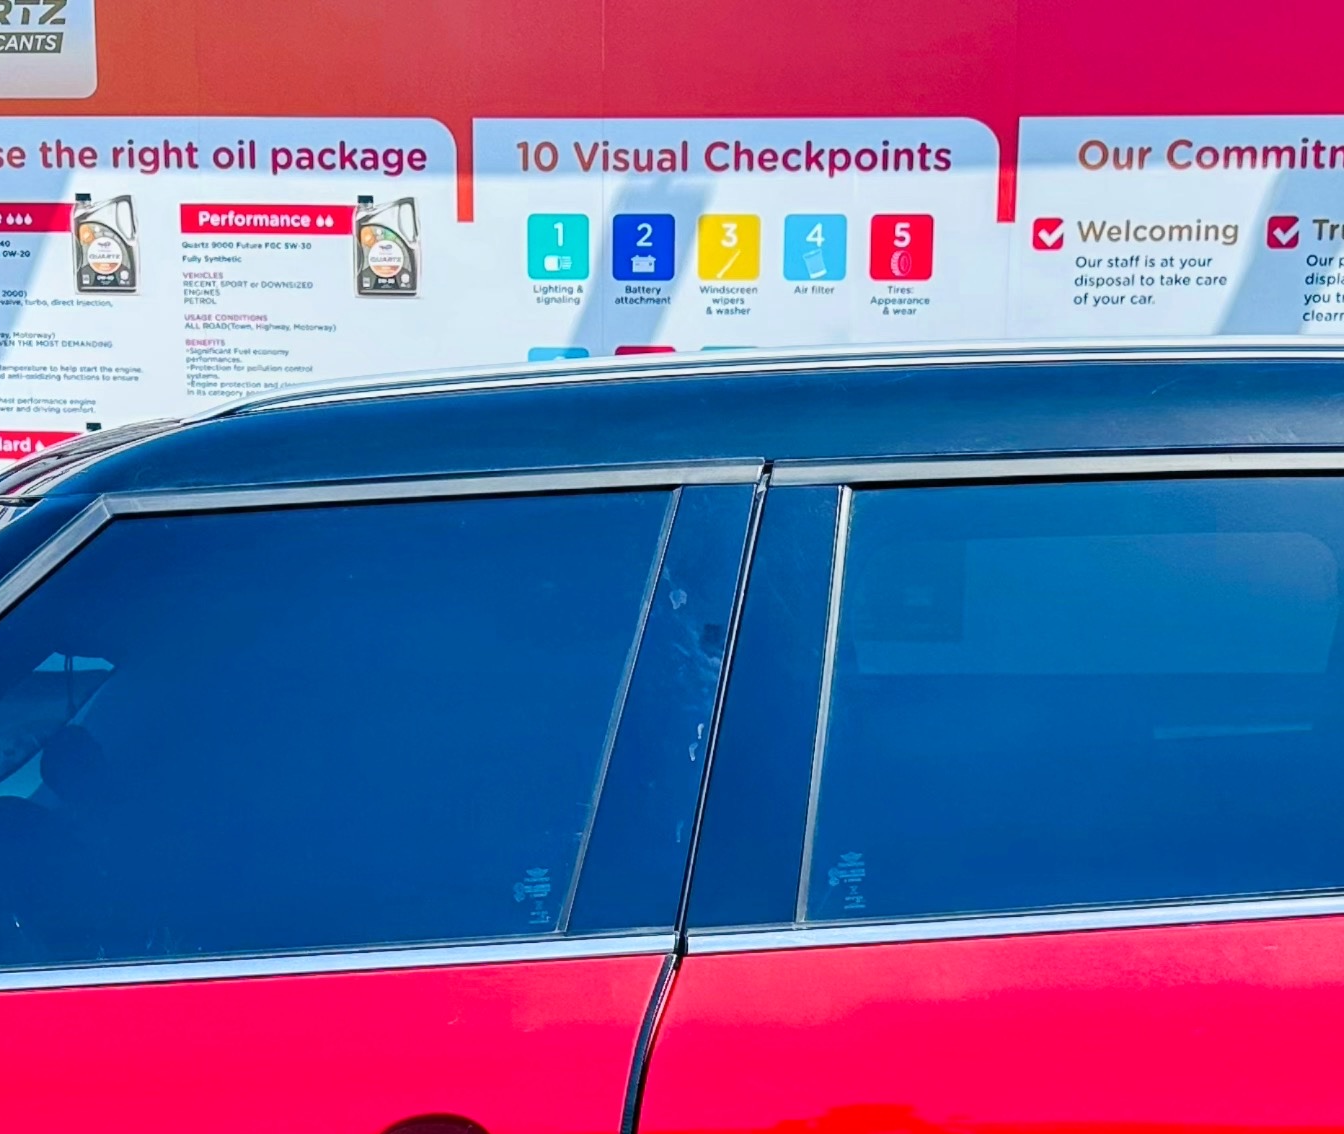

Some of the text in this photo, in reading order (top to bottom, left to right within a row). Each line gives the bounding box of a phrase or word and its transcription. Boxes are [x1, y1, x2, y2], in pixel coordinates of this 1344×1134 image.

[39, 139, 99, 171] the
[111, 139, 201, 176] right
[209, 139, 258, 171] oil
[270, 141, 429, 177] package
[516, 140, 953, 178] 10 Visual Checkpoints
[1077, 140, 1154, 171] Our
[198, 210, 312, 228] Performance
[553, 223, 564, 247] 1
[636, 223, 653, 247] 2
[721, 223, 739, 247] 3
[806, 222, 826, 248] 4
[893, 222, 912, 248] 5
[1076, 218, 1240, 247] Welcoming
[1074, 254, 1214, 271] Our staff is at your
[1305, 254, 1335, 268] Our
[1073, 273, 1229, 288] disposal to take care
[532, 285, 584, 296] Lighting &
[624, 285, 662, 296] Battery
[699, 285, 758, 295] Windscreen
[793, 285, 836, 295] Air filter
[535, 295, 581, 306] signaling
[614, 296, 672, 306] attachment
[711, 296, 746, 308] wipers
[869, 296, 931, 307] Appearance
[1072, 292, 1089, 306] of
[1092, 294, 1127, 308] your
[1303, 293, 1331, 306] you
[715, 306, 752, 316] washer
[892, 306, 918, 316] wear
